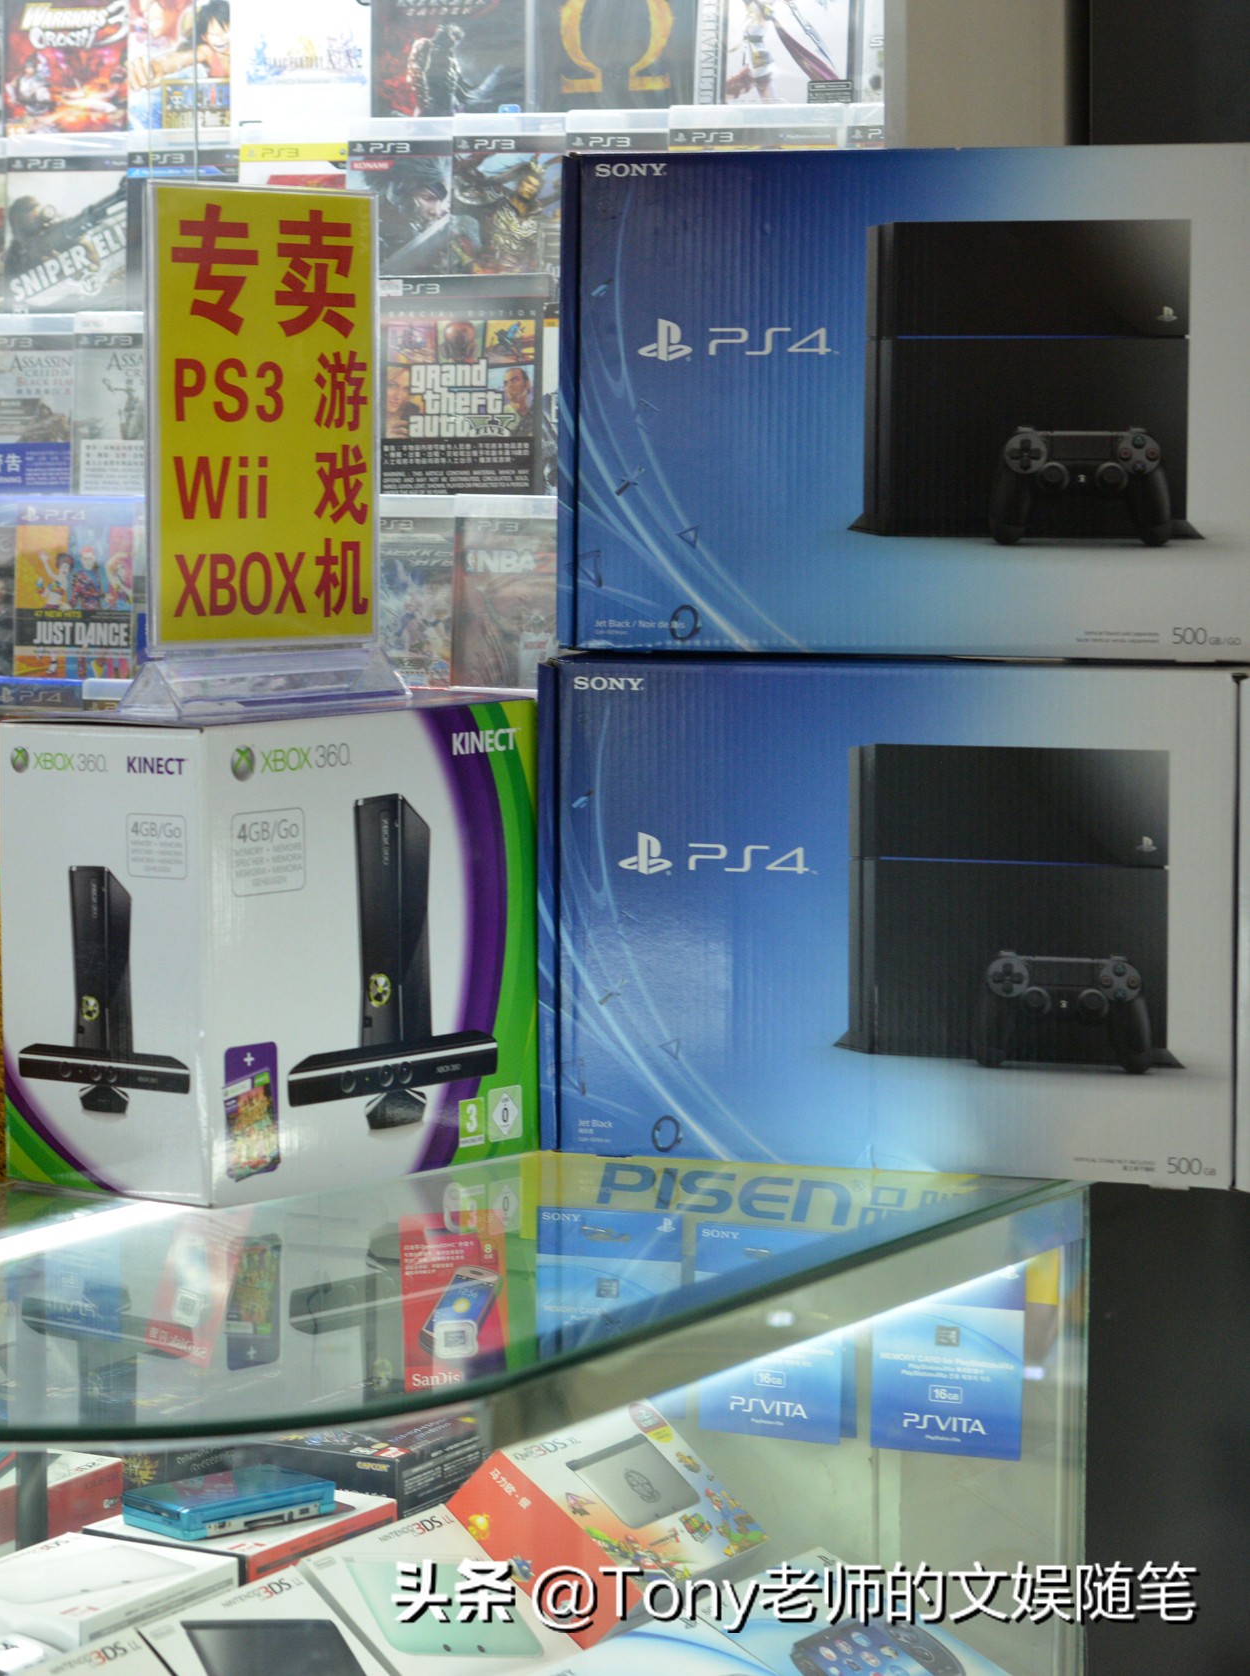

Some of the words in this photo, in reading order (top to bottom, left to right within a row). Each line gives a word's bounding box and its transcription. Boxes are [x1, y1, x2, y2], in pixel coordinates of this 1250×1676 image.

[369, 142, 411, 153] PS3
[473, 139, 516, 150] PS3
[588, 136, 632, 147] PS3
[691, 131, 735, 143] PS3
[26, 158, 67, 169] PS3
[149, 153, 186, 164] PS3
[594, 163, 667, 178] SONY
[10, 245, 91, 303] SNIPER
[171, 203, 357, 339] 专卖
[94, 335, 134, 346] PS3
[708, 327, 833, 356] PS4
[409, 358, 488, 393] grand
[173, 357, 285, 423] PS3
[422, 388, 504, 415] theft
[172, 455, 269, 520] Wii
[43, 508, 86, 520] PS4
[477, 520, 519, 532] PS3
[173, 550, 308, 618] XBOX
[607, 619, 631, 628] Black
[32, 621, 73, 645] JUST
[74, 621, 130, 648] DANCE
[1172, 626, 1208, 646] 500
[573, 675, 645, 691] SONY
[19, 690, 62, 703] PS4
[452, 728, 517, 756] KINECT
[33, 752, 76, 771] XBOX
[76, 753, 107, 772] 360
[126, 756, 185, 775] KINECT
[260, 747, 314, 774] XBOX
[314, 742, 351, 769] 360
[130, 821, 182, 839] 4GB/Go
[236, 818, 299, 843] 4GB/Go
[688, 843, 812, 874] PS4
[465, 1103, 478, 1133] 3
[501, 1107, 509, 1123] 0
[578, 1119, 590, 1128] Jet
[591, 1119, 613, 1128] Black
[1166, 1156, 1203, 1176] 500
[596, 1161, 854, 1227] PISEN
[541, 1211, 581, 1223] SONY
[701, 1228, 741, 1240] SONY
[729, 1395, 808, 1420] PSVITA
[902, 1412, 988, 1436] PSVITA
[410, 1516, 443, 1537] 3DS
[258, 1577, 291, 1600] 3DS
[91, 1643, 128, 1667] 3DS
